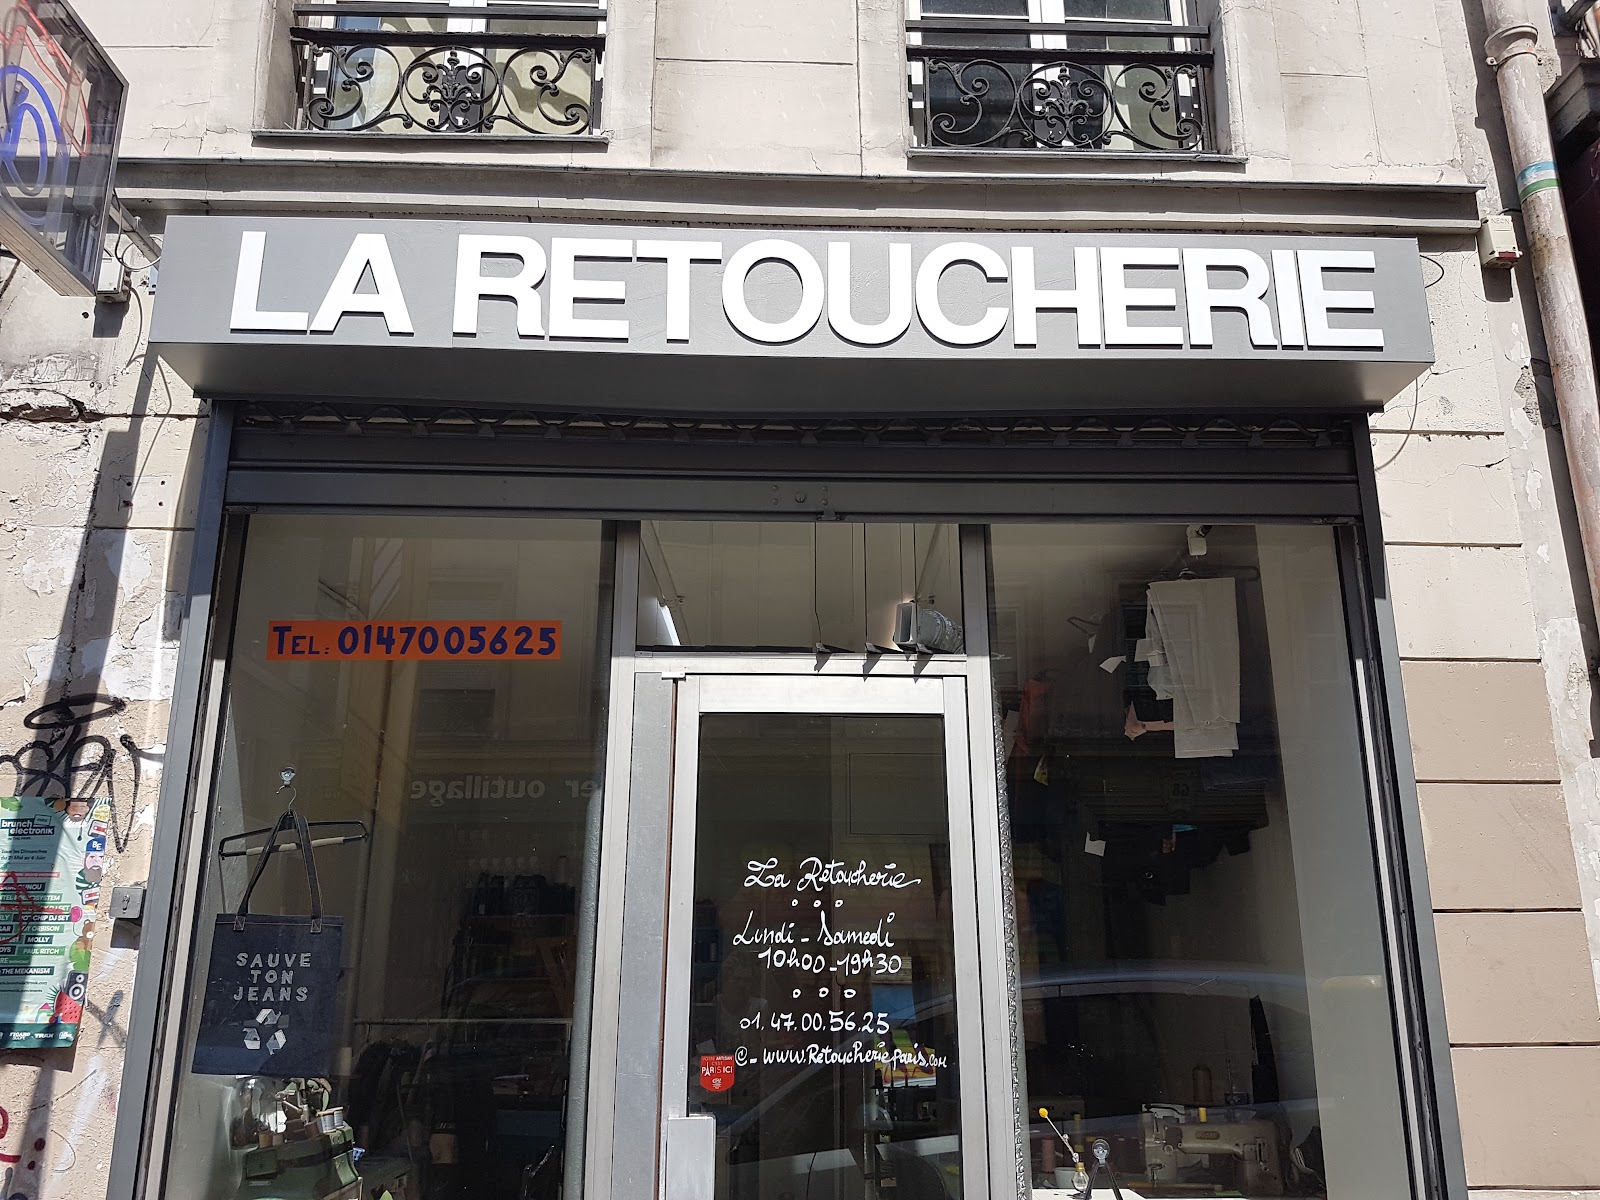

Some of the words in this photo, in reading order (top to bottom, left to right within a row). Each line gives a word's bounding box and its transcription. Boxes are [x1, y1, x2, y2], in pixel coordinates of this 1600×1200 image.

[229, 231, 414, 335] LA
[452, 234, 1385, 349] RETOUCHERIE
[337, 624, 557, 655] 0147005625
[1, 819, 33, 829] brunch
[9, 828, 53, 836] electronik
[92, 840, 103, 851] BE
[743, 857, 790, 888] La
[796, 856, 921, 891] Retoucherie
[732, 910, 795, 945] Lundi
[816, 909, 895, 947] Samedi
[235, 952, 312, 969] SAUVE
[14, 967, 51, 975] MEKANISM
[250, 969, 294, 985] TON
[233, 986, 309, 1003] JEANS
[722, 1065, 733, 1074] ICI
